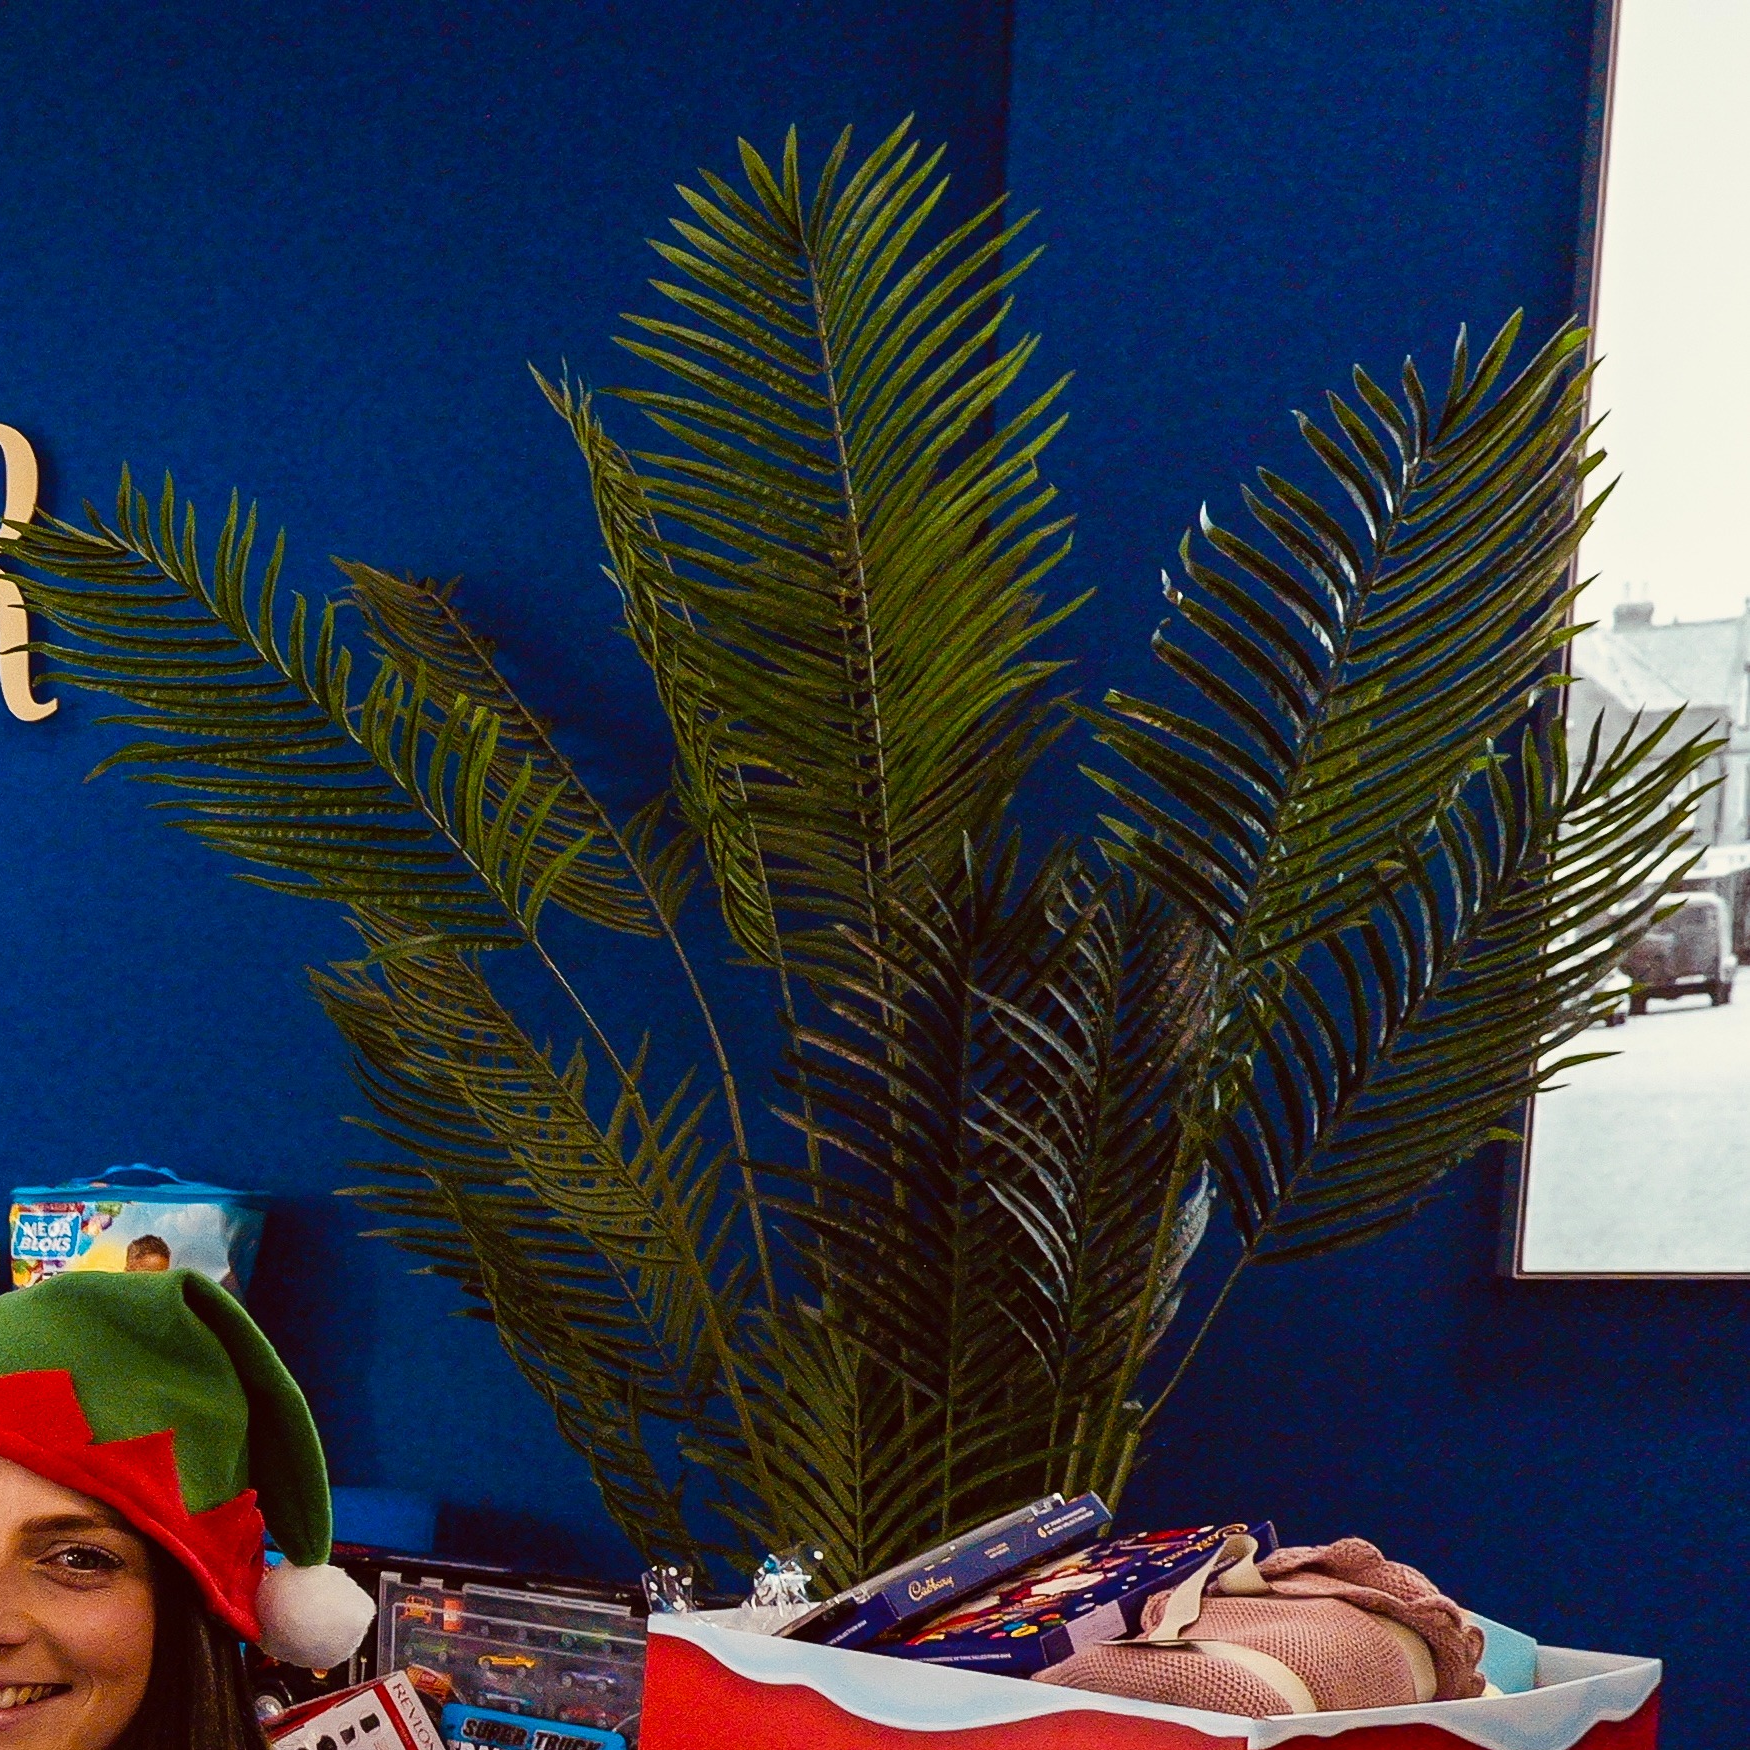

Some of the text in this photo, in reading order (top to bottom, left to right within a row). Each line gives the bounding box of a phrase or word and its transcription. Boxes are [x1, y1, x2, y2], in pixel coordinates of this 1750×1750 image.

[23, 1219, 73, 1238] MEGA
[18, 1236, 72, 1251] BLOKS
[461, 1718, 530, 1748] SUPER
